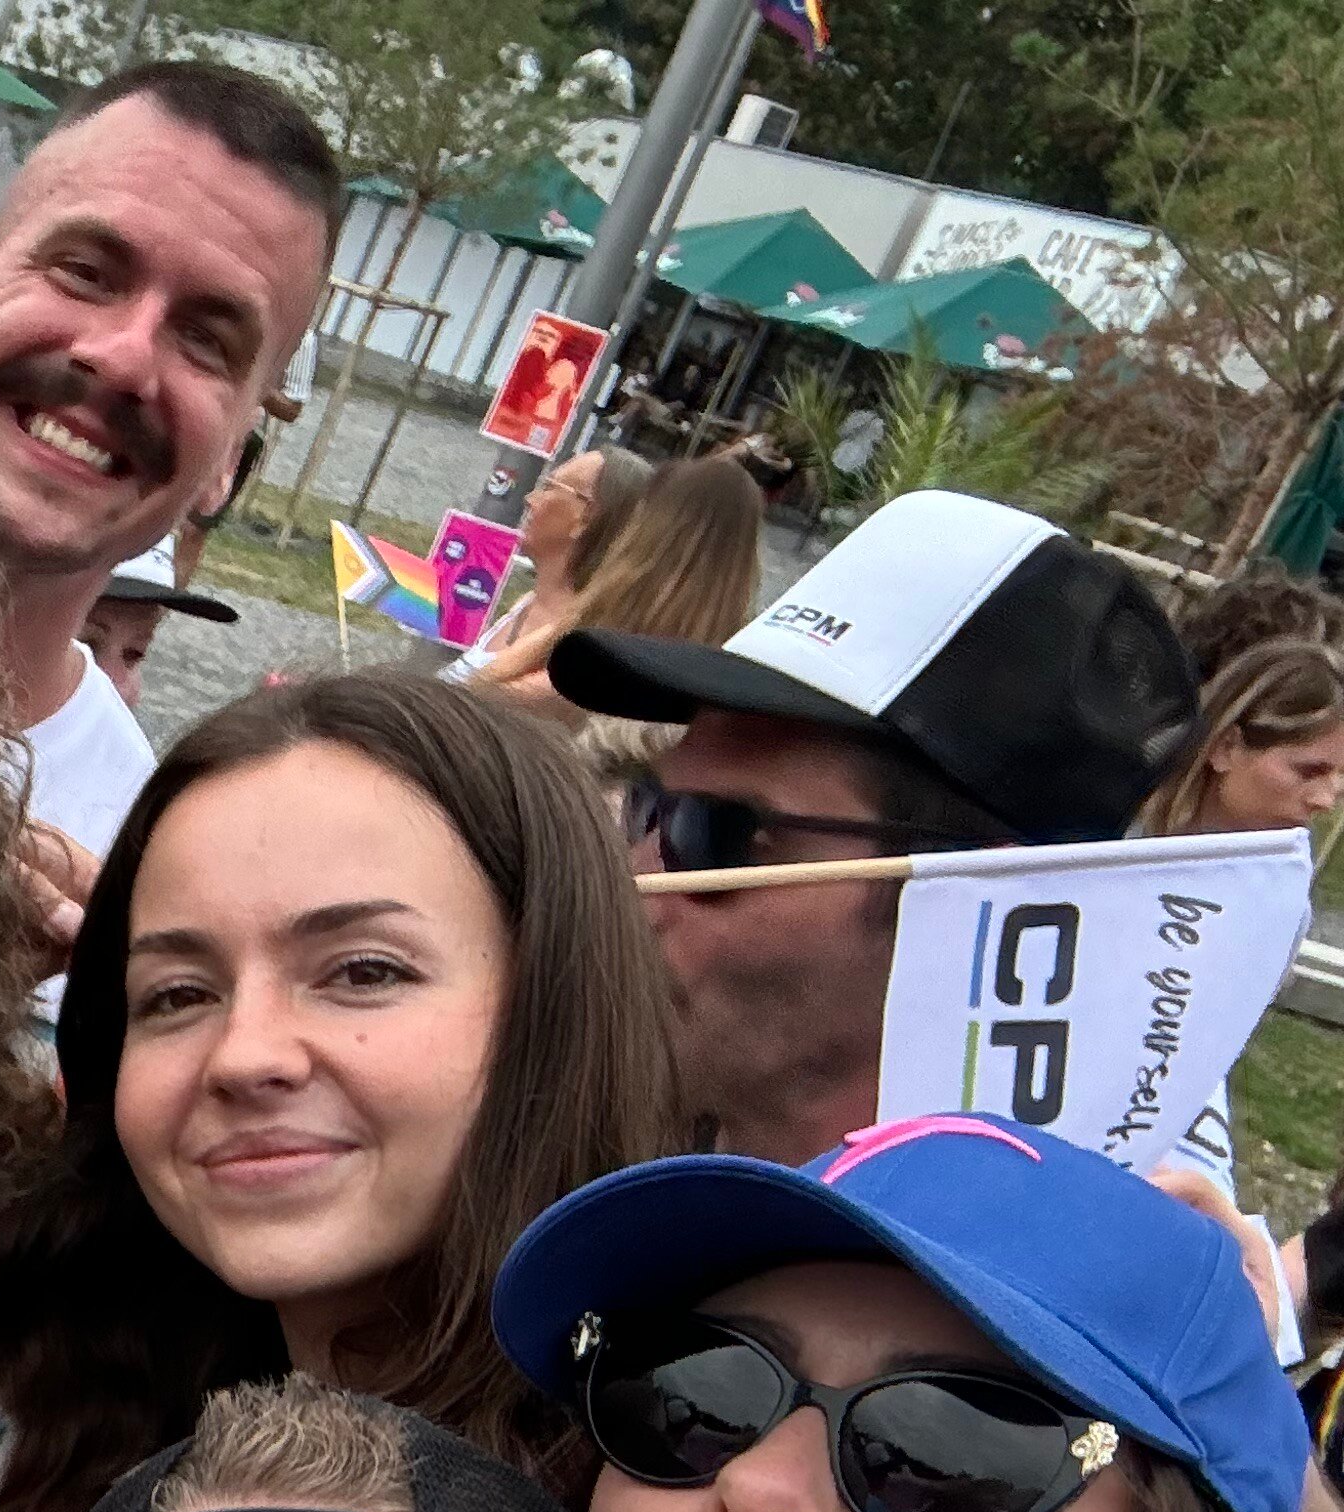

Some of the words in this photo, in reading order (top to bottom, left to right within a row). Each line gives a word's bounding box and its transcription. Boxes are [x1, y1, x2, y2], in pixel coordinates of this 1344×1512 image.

[771, 604, 853, 641] CPM
[1158, 892, 1223, 952] be
[990, 901, 1081, 1126] CP
